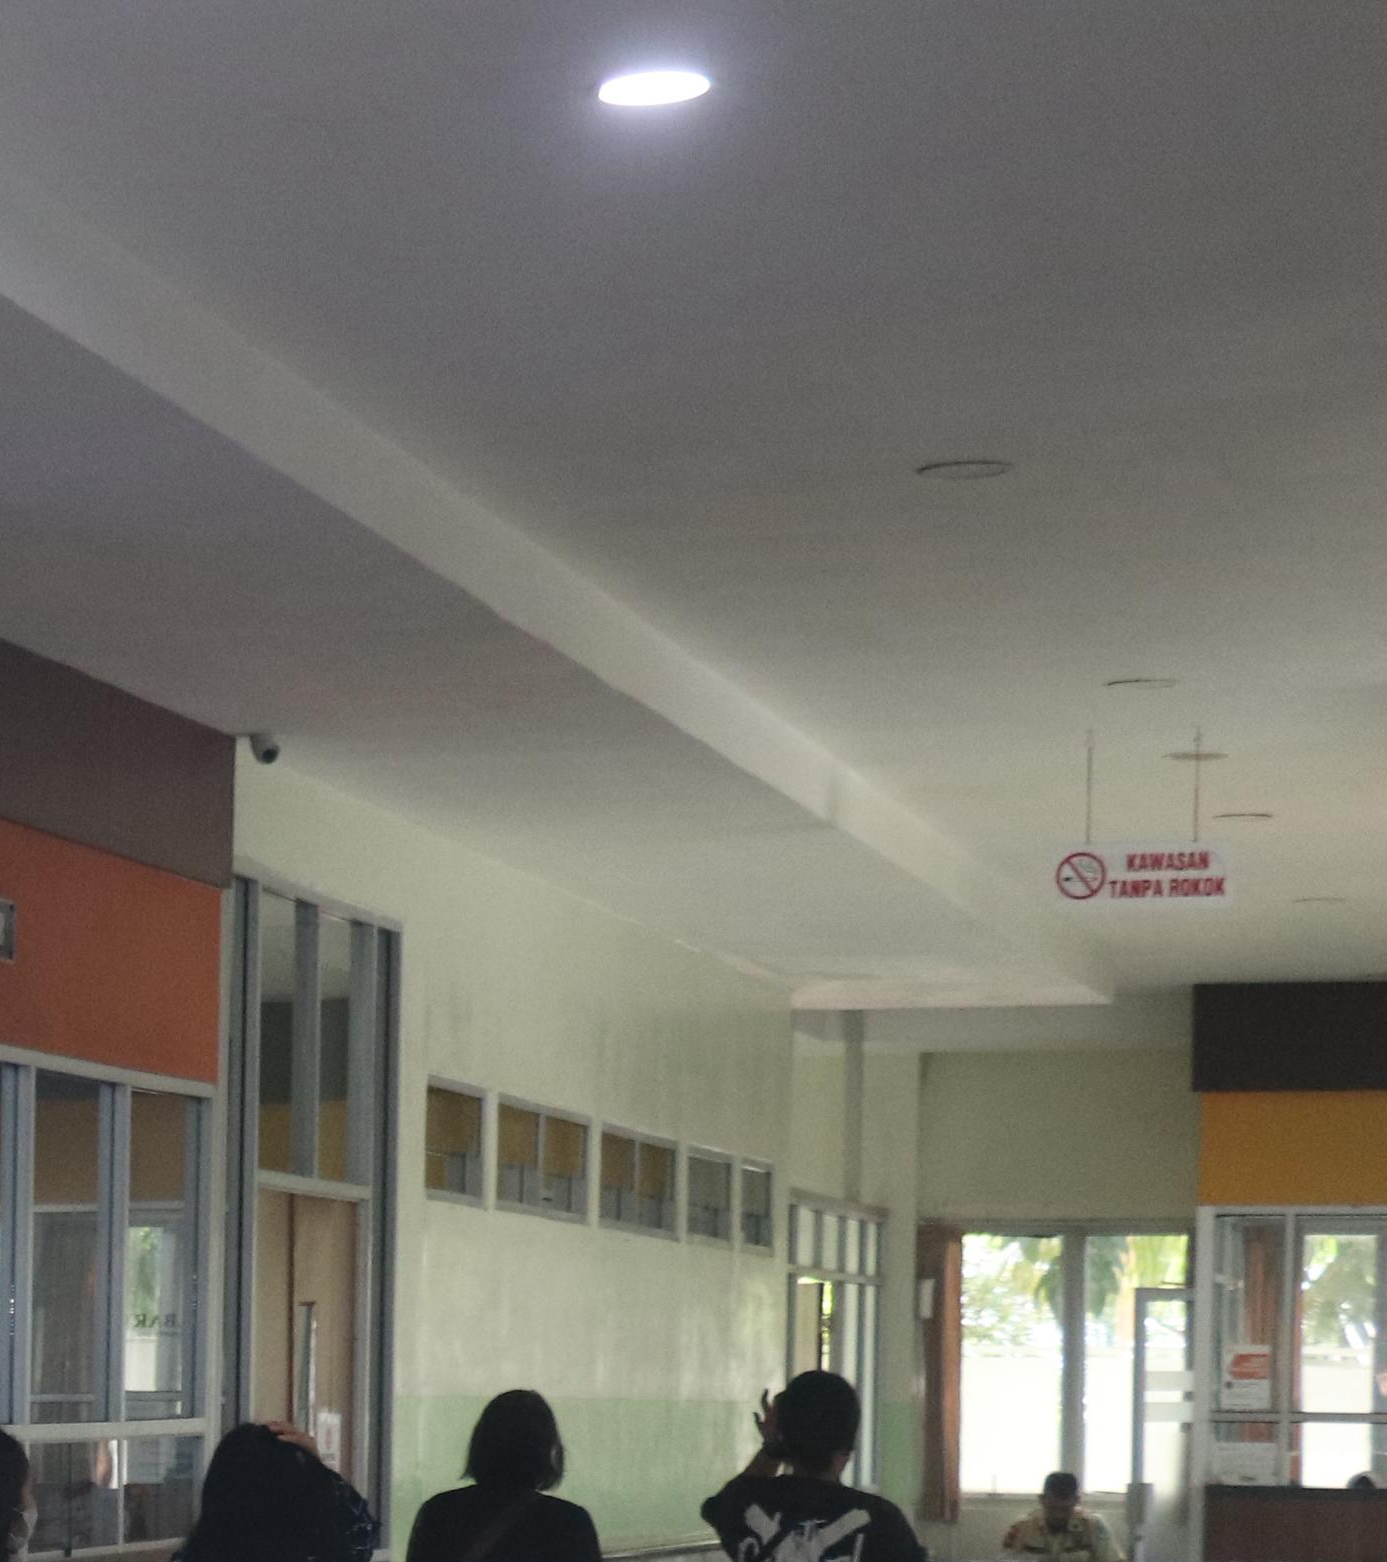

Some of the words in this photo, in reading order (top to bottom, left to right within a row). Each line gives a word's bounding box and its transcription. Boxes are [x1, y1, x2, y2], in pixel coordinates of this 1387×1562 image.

[1127, 852, 1209, 872] KAWASAN
[1110, 880, 1163, 898] TANPA
[1170, 877, 1224, 897] ROKOK
